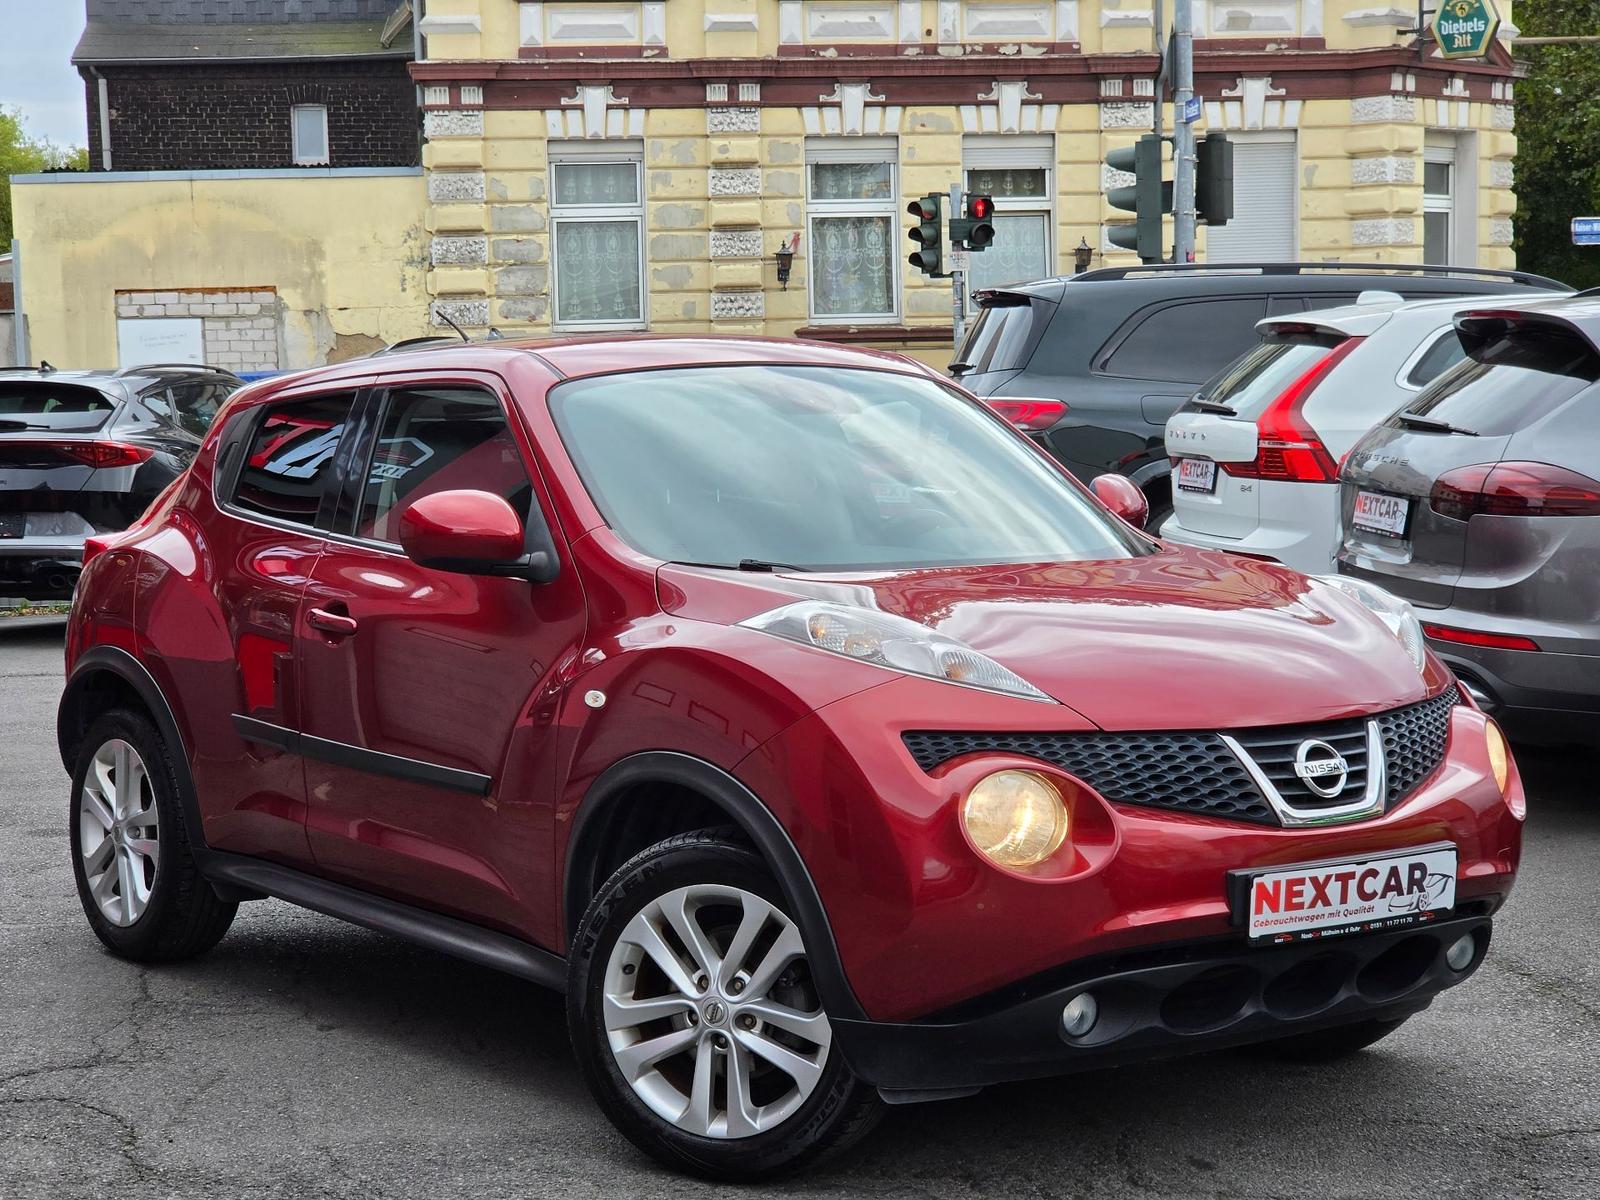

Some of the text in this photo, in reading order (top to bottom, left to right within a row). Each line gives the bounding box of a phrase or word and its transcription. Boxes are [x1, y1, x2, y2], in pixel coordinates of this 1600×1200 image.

[1440, 17, 1485, 35] Diebels
[1452, 33, 1472, 48] Alt
[1181, 461, 1209, 480] NEXTCAR
[1355, 495, 1399, 520] NEXTCAR
[1304, 762, 1347, 775] NISSAN
[1254, 862, 1428, 916] NEXTCAR
[1253, 905, 1375, 928] Gebrauchtwagen mit Qualität
